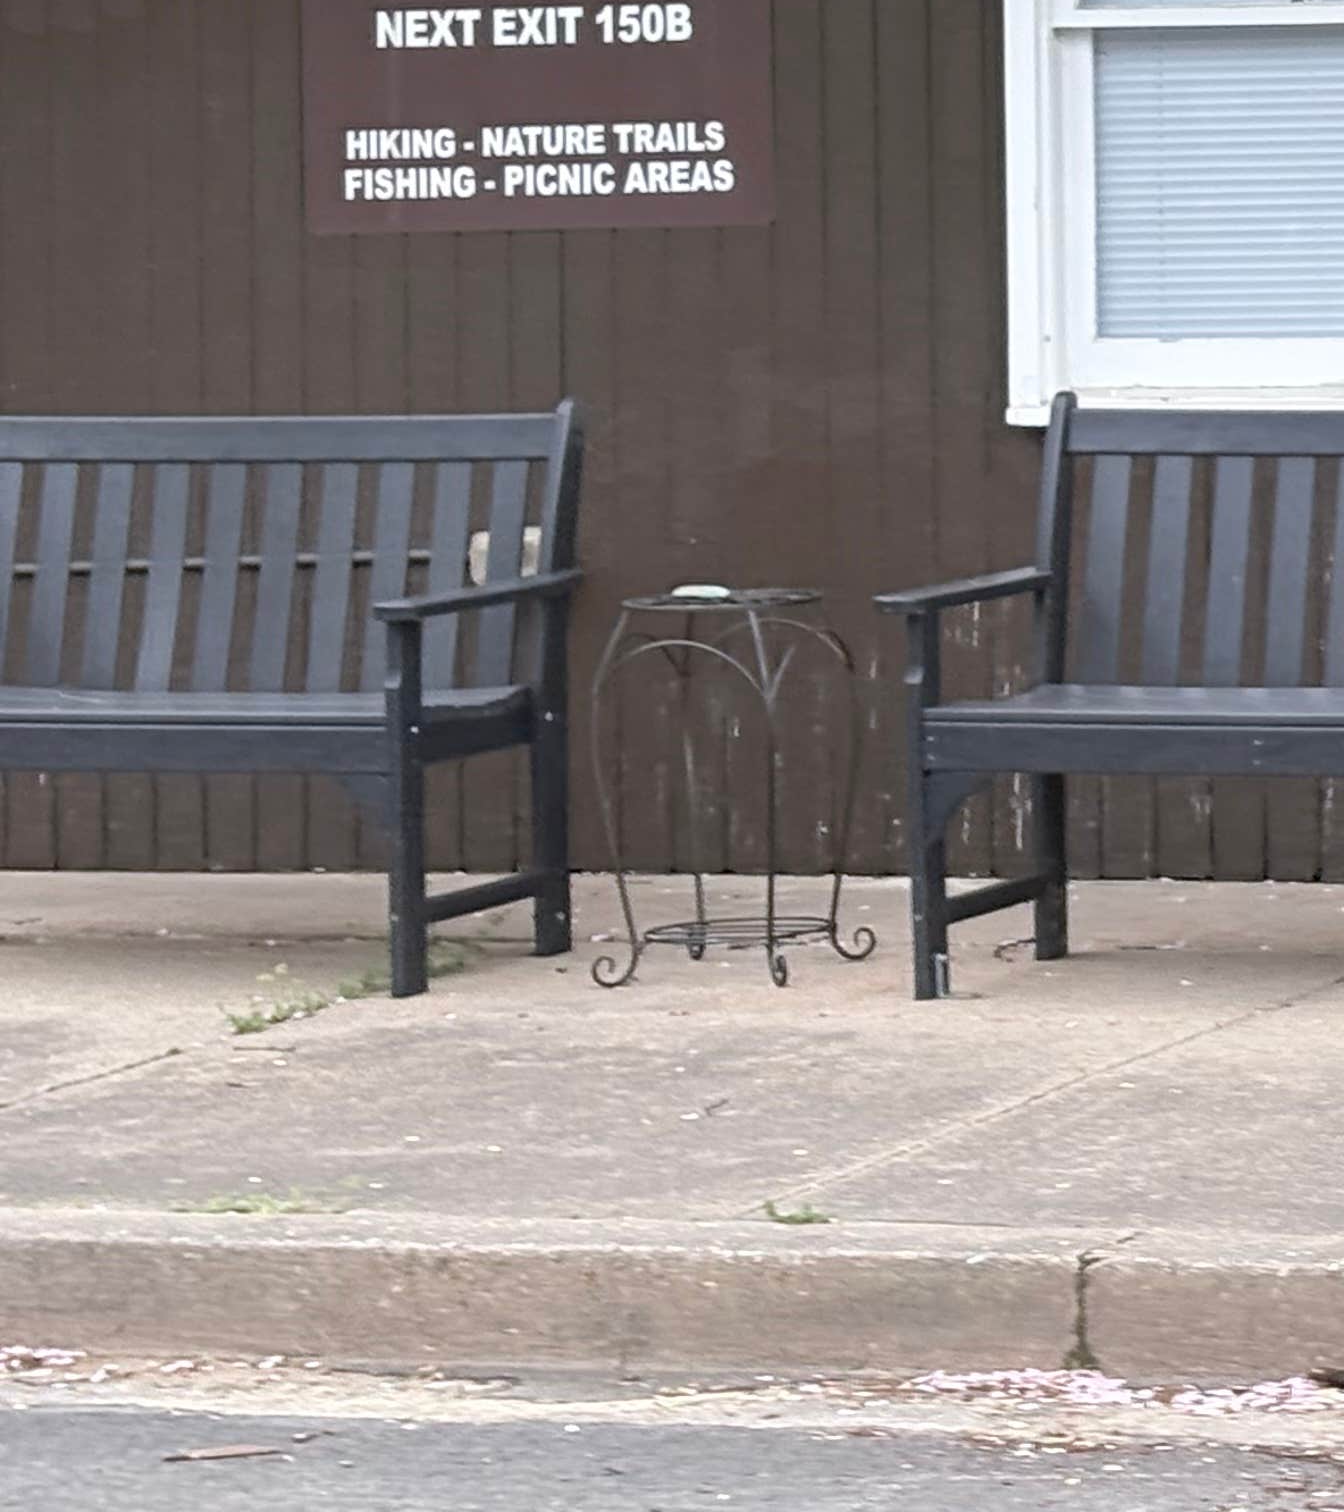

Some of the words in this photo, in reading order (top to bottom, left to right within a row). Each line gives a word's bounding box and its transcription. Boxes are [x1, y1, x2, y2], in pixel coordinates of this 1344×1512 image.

[375, 9, 481, 49] NEXT
[493, 6, 584, 46] EXIT
[595, 3, 693, 44] 150B
[345, 128, 456, 160] HIKING
[481, 124, 606, 157] NATURE
[613, 121, 725, 154] TRAILS
[343, 166, 477, 200] FISHING
[504, 162, 616, 197] PICNIC
[623, 159, 735, 194] AREAS
